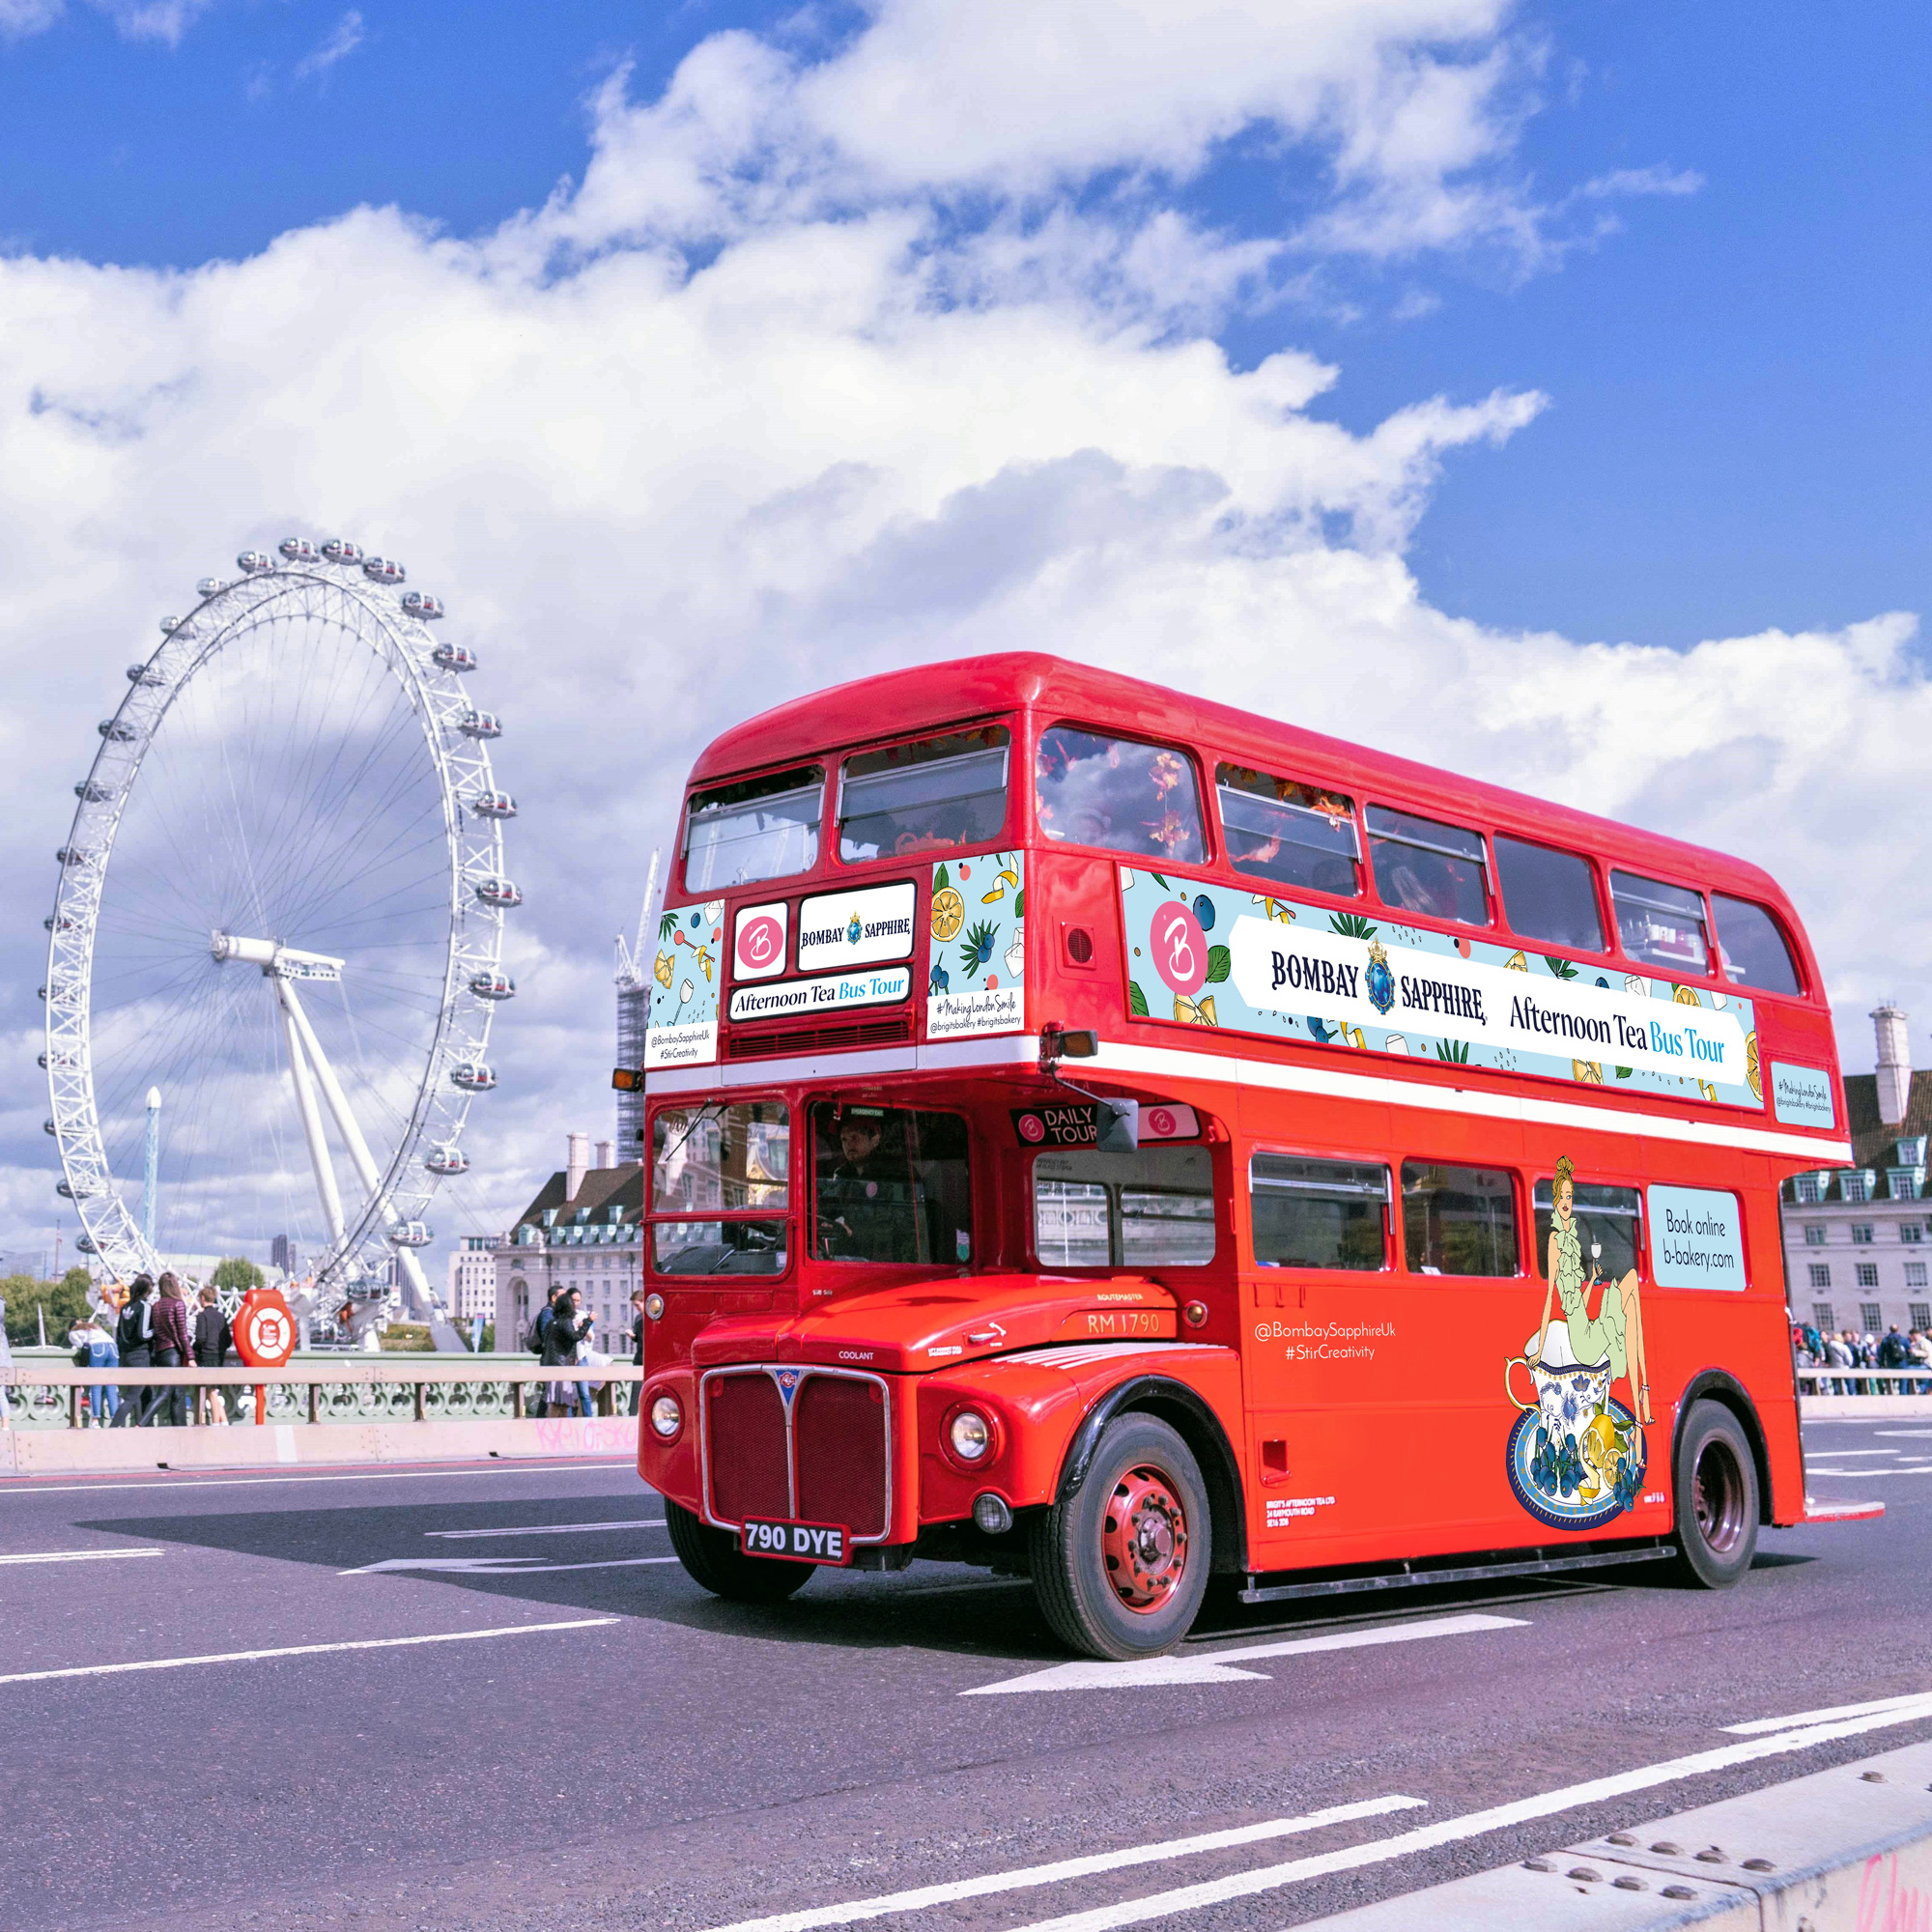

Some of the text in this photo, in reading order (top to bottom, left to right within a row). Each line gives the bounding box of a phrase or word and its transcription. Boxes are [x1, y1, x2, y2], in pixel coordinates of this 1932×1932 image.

[801, 918, 911, 950] BOMBAY SAPPHIRE
[735, 978, 904, 1013] Afternoon Tea Bus Tour
[1271, 951, 1487, 1026] BOMBAY SAPPHIRE
[930, 1013, 1022, 1034] @brigitsbakery #brigitsbakery
[1510, 995, 1725, 1064] Afternoon Tea Bus Tour
[651, 1029, 710, 1048] @BombaySapphireUk
[660, 1047, 698, 1060] #StirCreativity
[1044, 1107, 1092, 1126] DAILY
[1051, 1126, 1097, 1144] TOUR
[1666, 1208, 1725, 1236] Book online
[1663, 1238, 1734, 1272] b-bakery.com
[1097, 1293, 1143, 1301] ROUTEMASTER
[1088, 1313, 1159, 1333] RM 1790
[1254, 1321, 1396, 1342] @BombaySapphireUk
[838, 1350, 874, 1361] COOLANT
[1286, 1344, 1376, 1360] #StirCreativity
[1286, 1498, 1316, 1508] AFTERNOON
[1316, 1496, 1325, 1506] TEA
[1300, 1507, 1315, 1516] ROAD
[745, 1523, 842, 1558] 790 DYE
